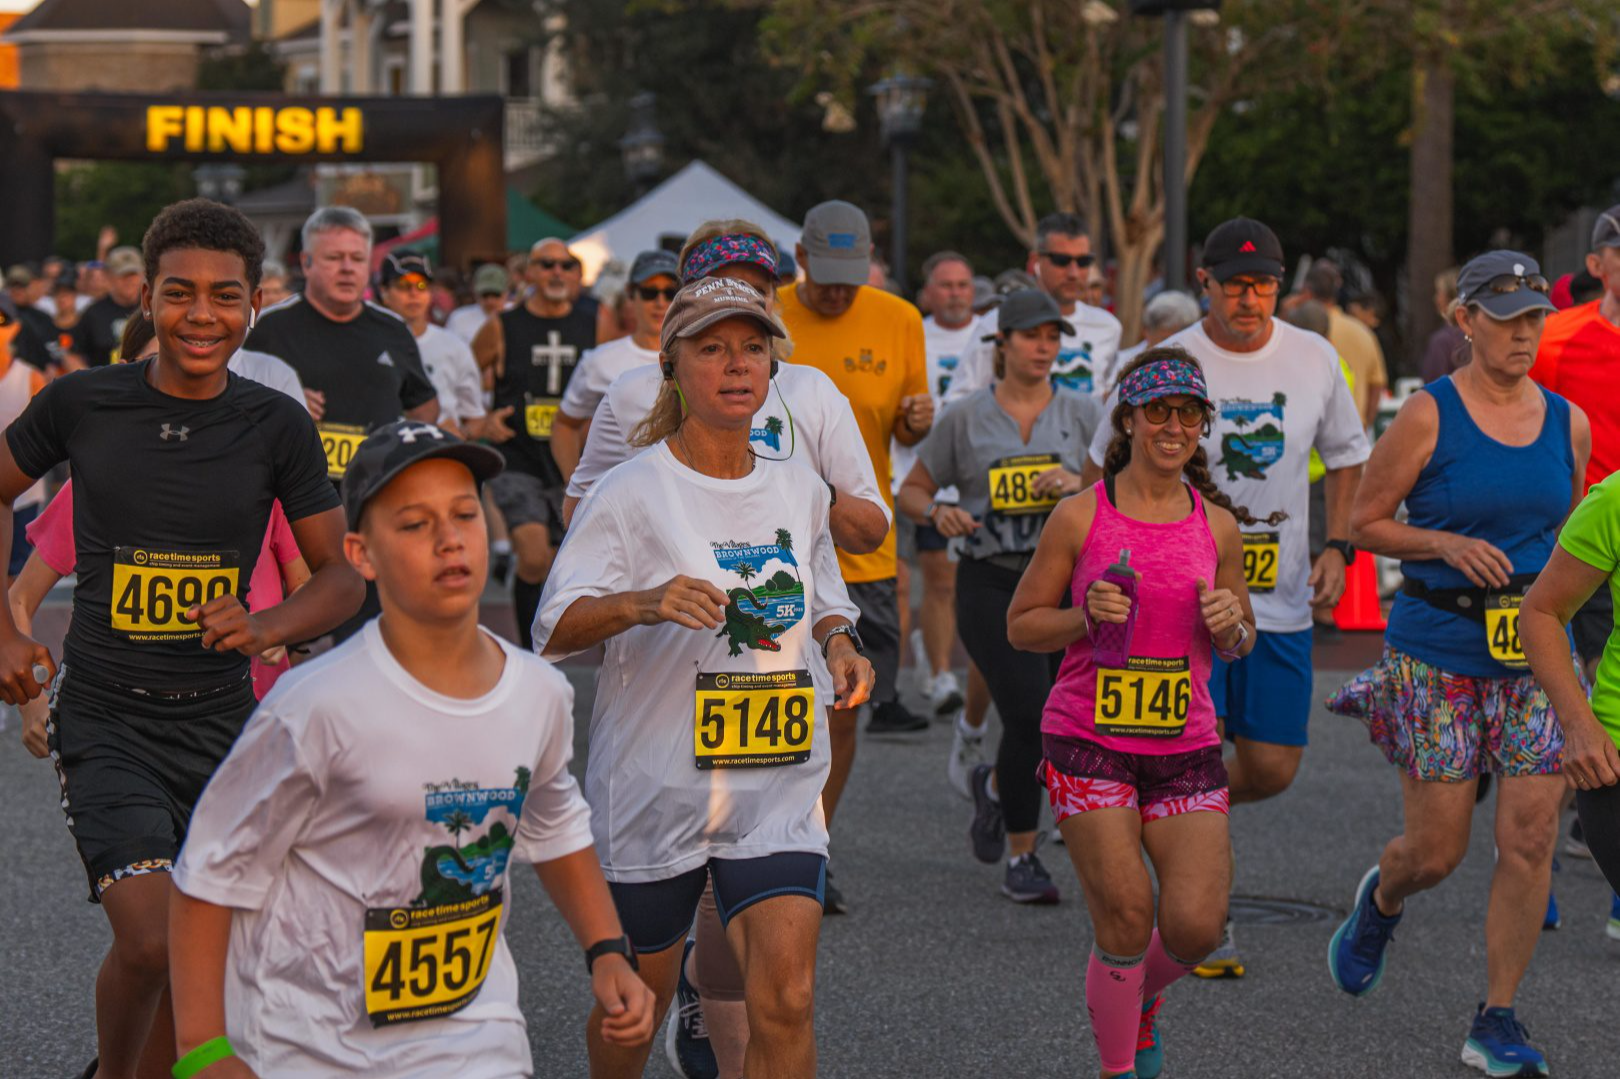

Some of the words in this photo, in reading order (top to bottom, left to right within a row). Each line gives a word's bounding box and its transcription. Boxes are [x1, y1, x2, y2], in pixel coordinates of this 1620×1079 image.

[147, 106, 363, 153] FINISH
[695, 279, 724, 298] PENN
[715, 547, 780, 558] BROWNWOOD
[1244, 550, 1275, 583] 92
[776, 604, 795, 618] 5K
[1101, 675, 1190, 721] 5146
[701, 695, 808, 749] 5148
[712, 755, 795, 766] www.racetimesports.com
[427, 790, 516, 806] BROWNWOOD
[372, 915, 497, 1001] 4557
